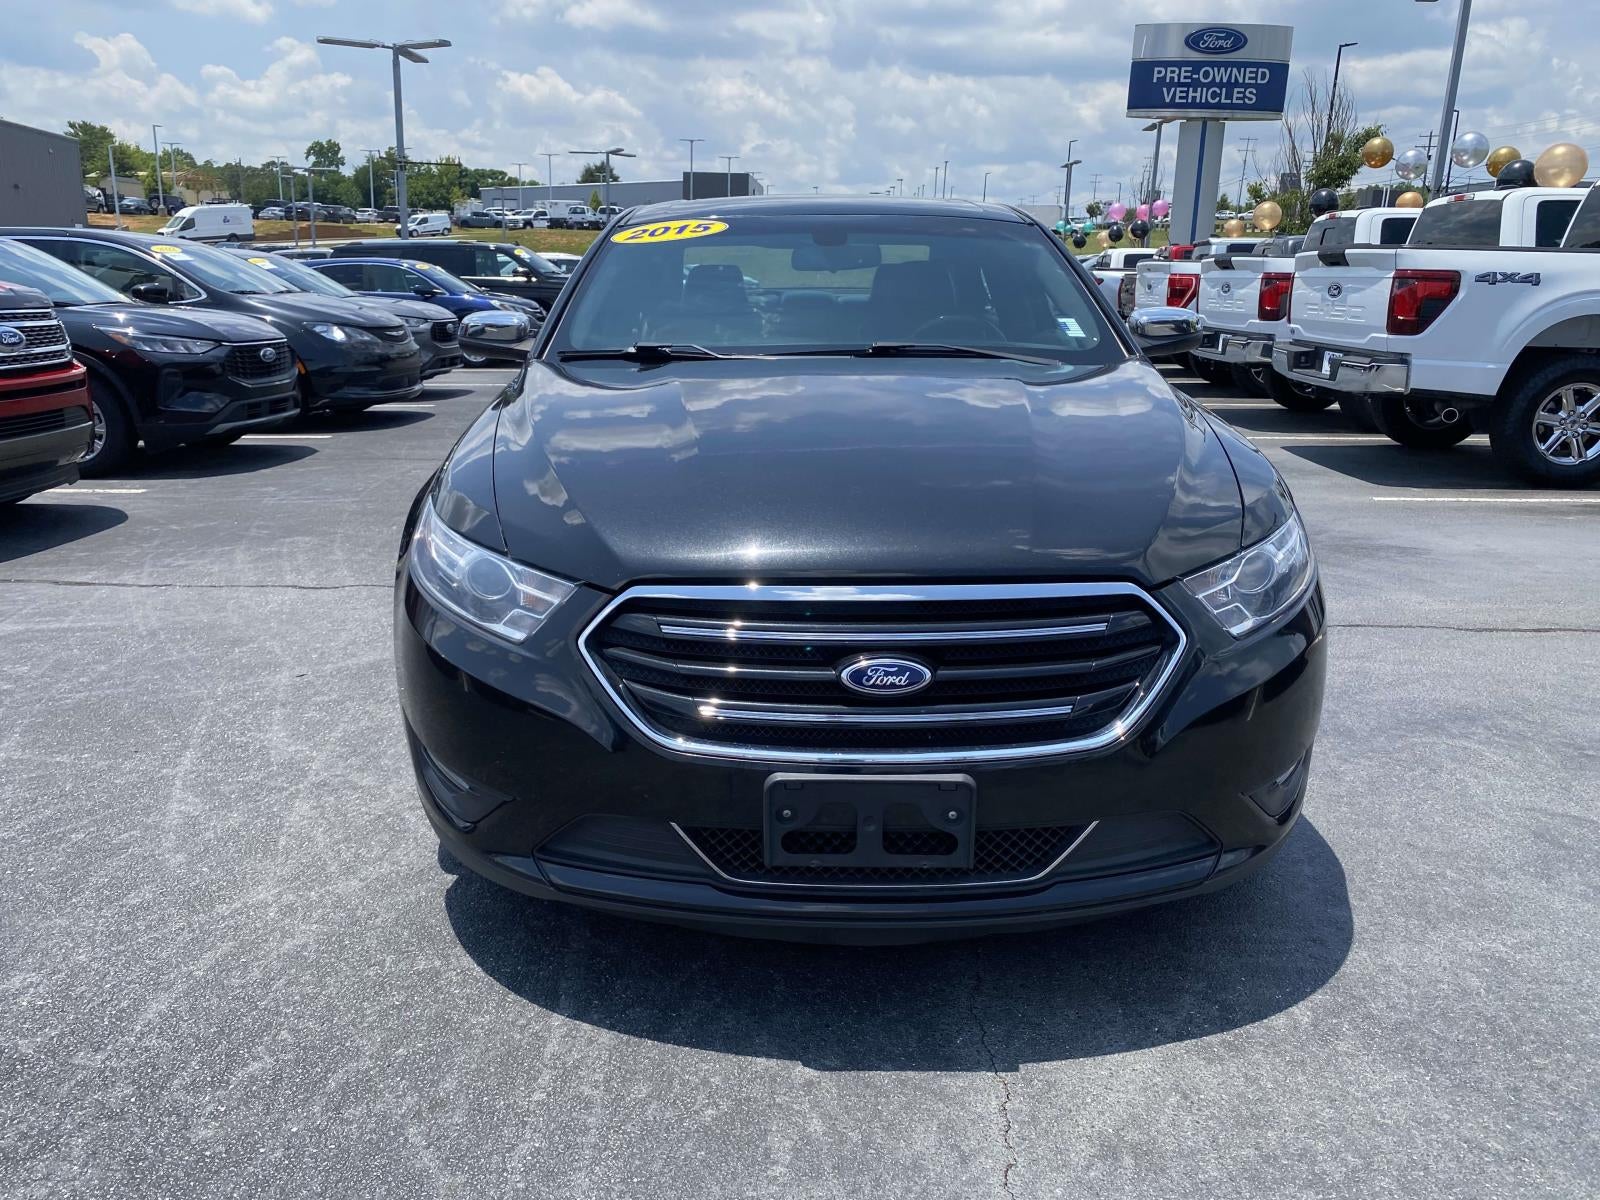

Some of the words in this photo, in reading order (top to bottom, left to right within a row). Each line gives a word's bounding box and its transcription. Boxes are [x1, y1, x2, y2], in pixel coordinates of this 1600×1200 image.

[1199, 32, 1234, 49] Ford
[1153, 66, 1270, 84] PRE-OWNED
[1162, 87, 1257, 104] VEHICLES
[623, 222, 715, 241] 2015
[862, 666, 909, 686] Ford
